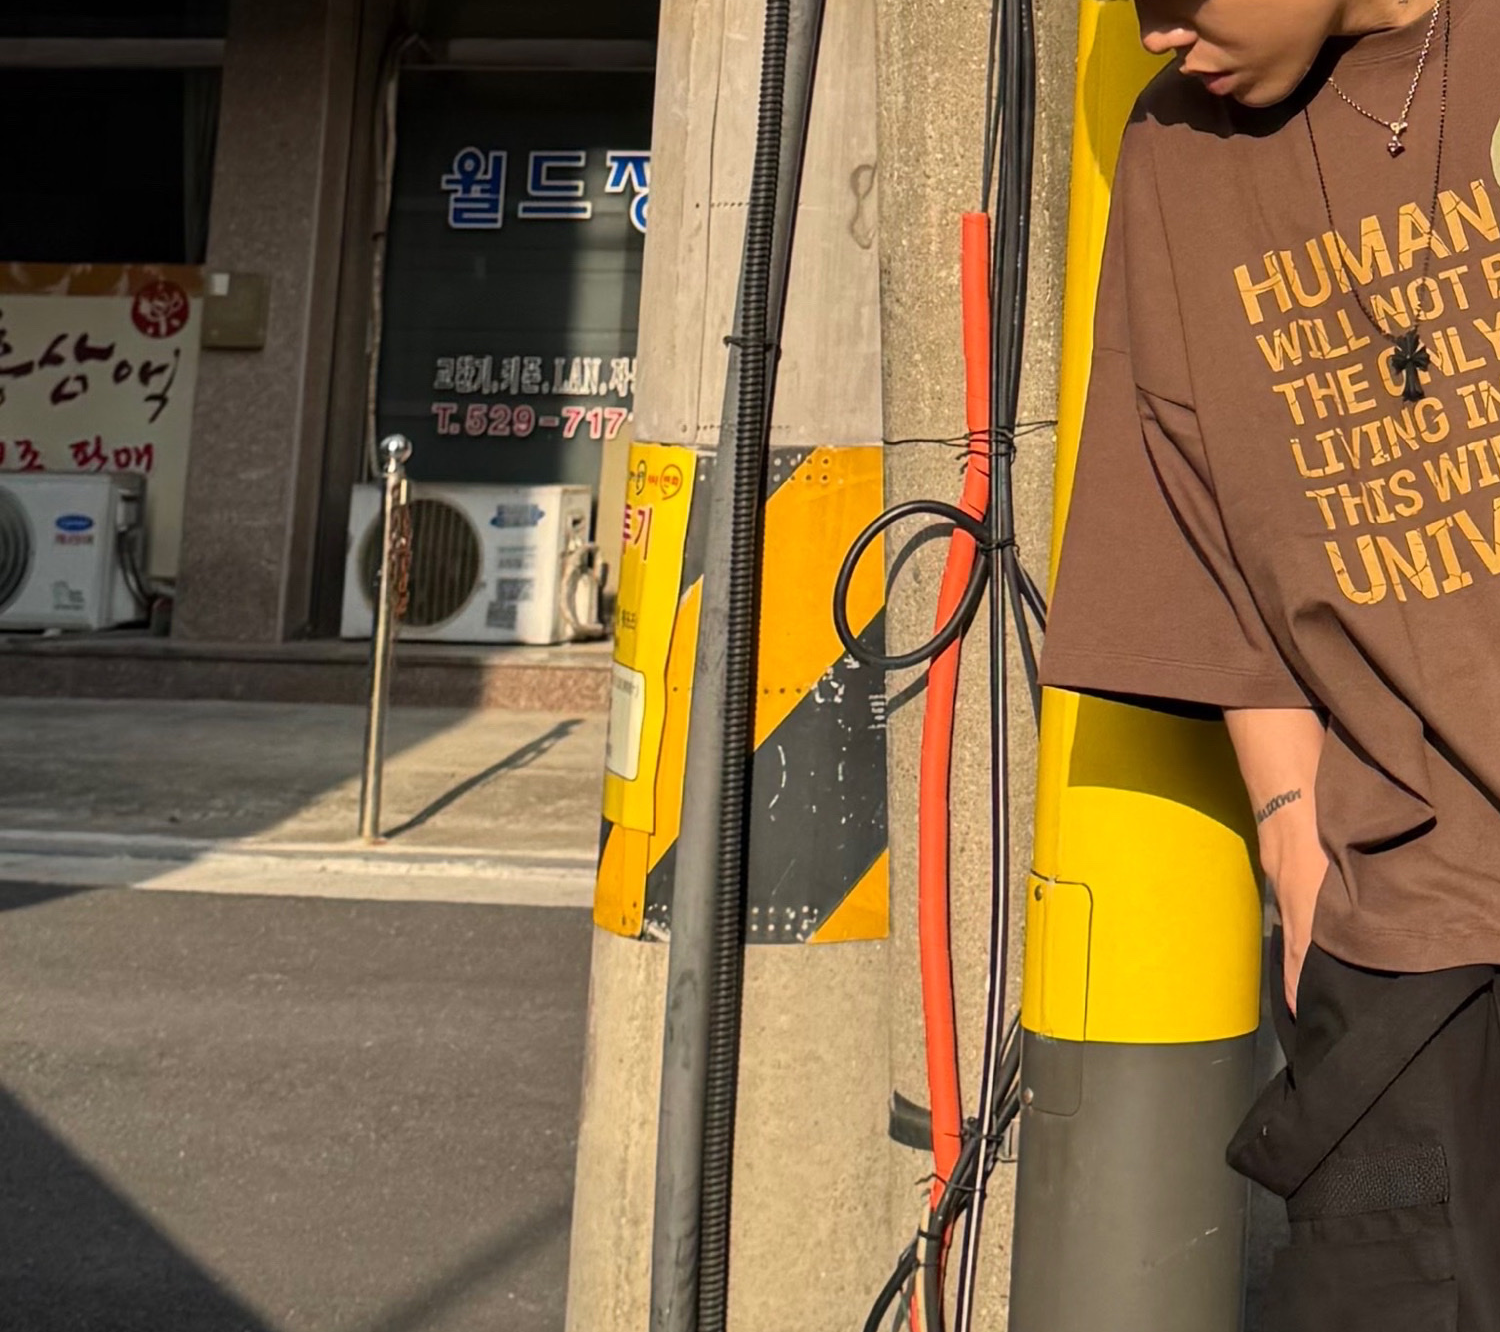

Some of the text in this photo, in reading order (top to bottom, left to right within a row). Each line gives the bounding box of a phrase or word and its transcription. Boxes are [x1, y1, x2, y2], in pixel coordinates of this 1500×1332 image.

[1234, 179, 1500, 325] HUMAN
[1255, 309, 1371, 372] WILL
[1369, 265, 1469, 334] NOT
[431, 402, 634, 440] T.529-717
[1272, 363, 1377, 425] THE
[69, 434, 154, 472] 판매
[1290, 397, 1450, 478] LIVING
[1305, 469, 1424, 530] THIS
